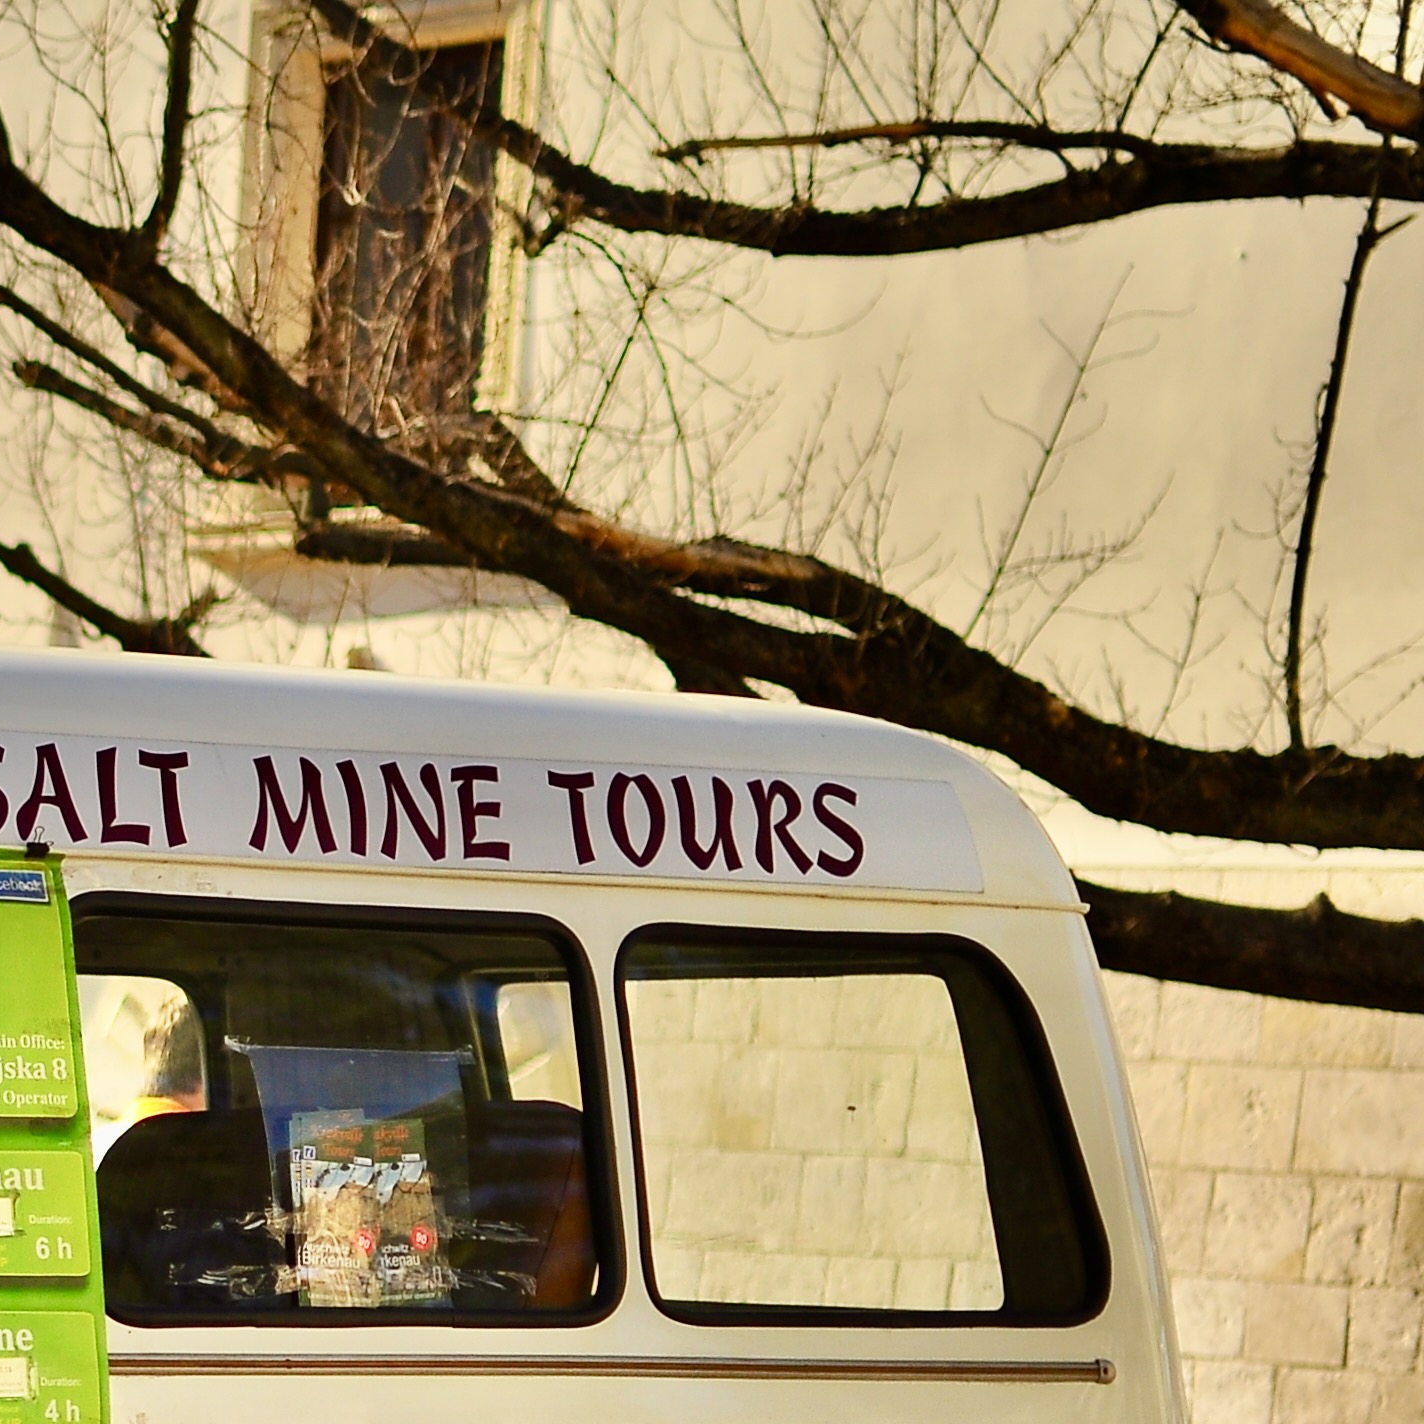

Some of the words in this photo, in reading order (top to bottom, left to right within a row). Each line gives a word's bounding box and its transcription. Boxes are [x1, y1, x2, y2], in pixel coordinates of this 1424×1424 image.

[249, 755, 510, 861] MINE
[548, 771, 863, 877] TOURS
[20, 1035, 65, 1049] Office:
[53, 1058, 67, 1080] 8
[3, 1091, 67, 1108] Operator
[29, 1215, 72, 1224] Duration:
[36, 1237, 49, 1259] 6
[57, 1237, 72, 1259] h
[303, 1251, 360, 1269] Birkenau
[41, 1377, 81, 1387] Duration:
[45, 1400, 59, 1422] 4
[67, 1400, 80, 1422] h
